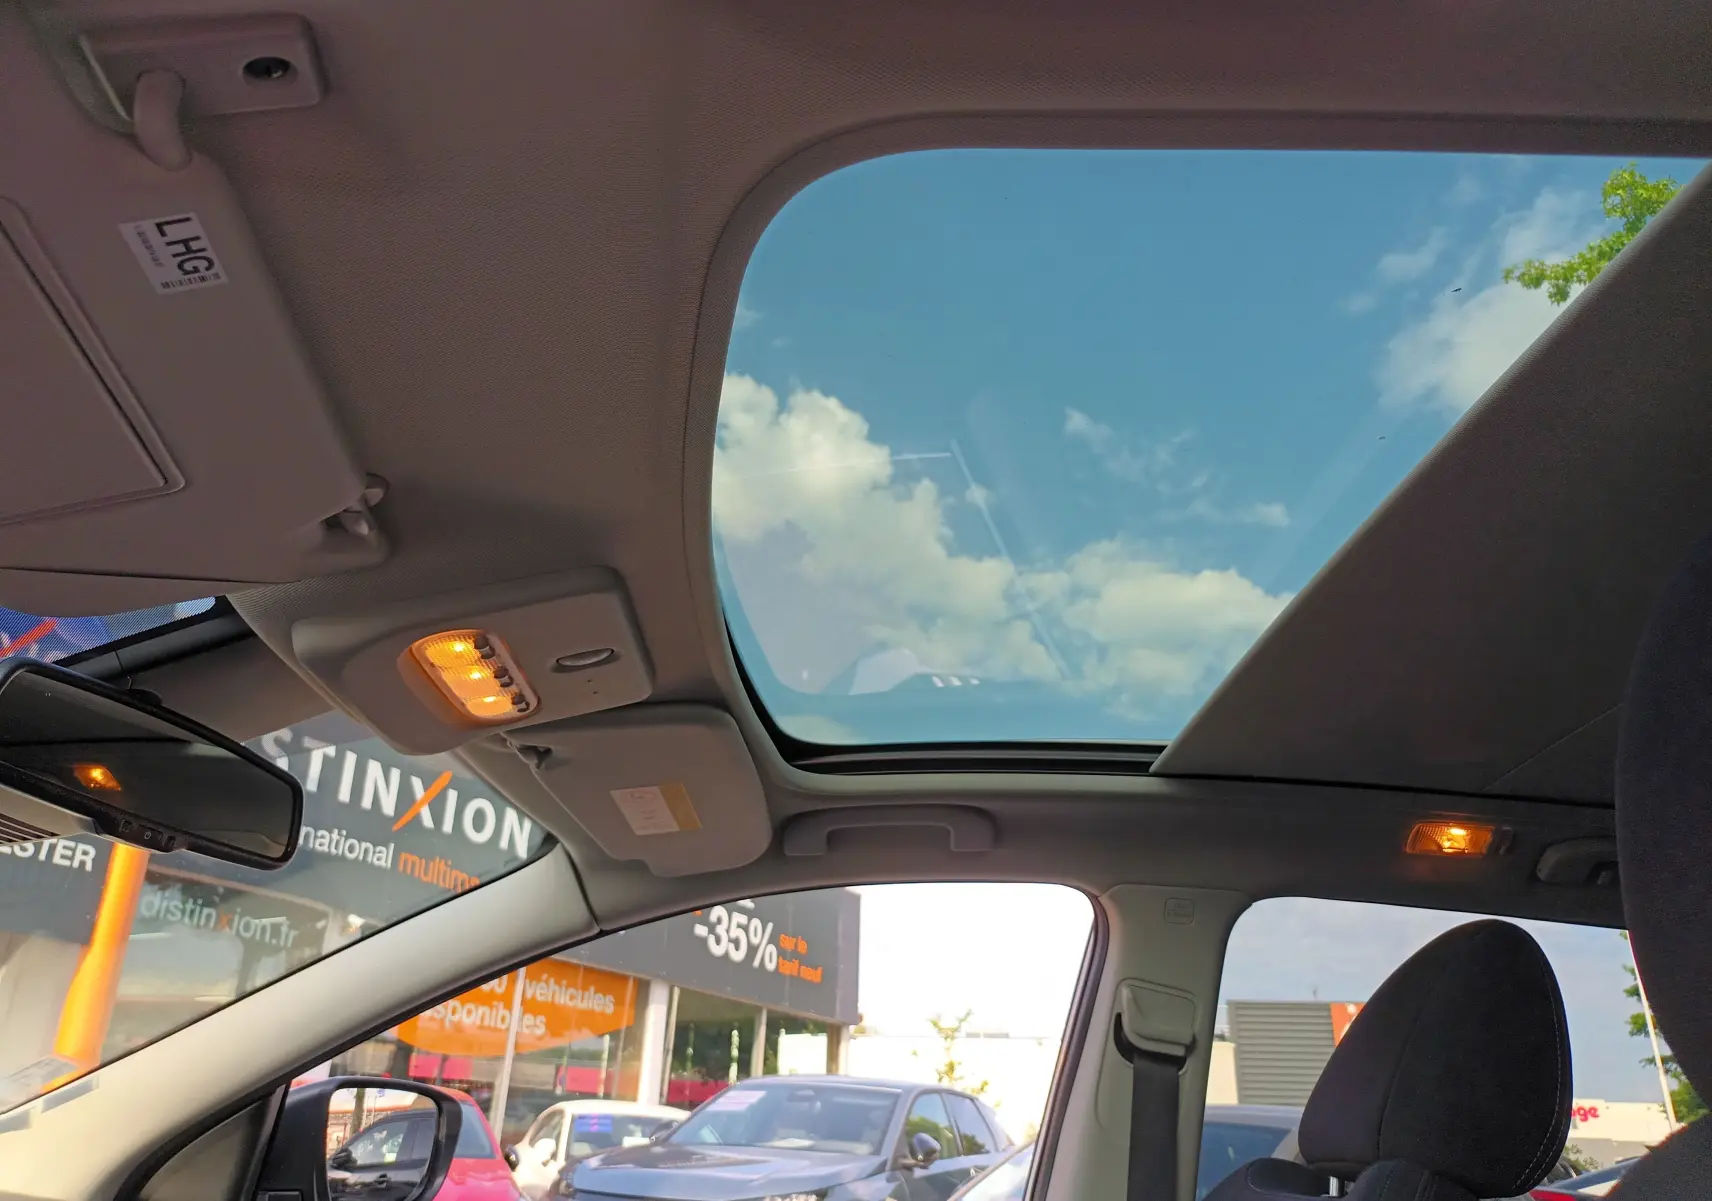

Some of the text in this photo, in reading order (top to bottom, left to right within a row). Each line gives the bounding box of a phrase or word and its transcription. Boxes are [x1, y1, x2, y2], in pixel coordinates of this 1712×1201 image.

[154, 217, 215, 276] LHG
[140, 890, 300, 948] distinxion.fr
[693, 905, 777, 972] -35%
[419, 1000, 547, 1035] sponibles
[524, 973, 616, 1014] véhicules
